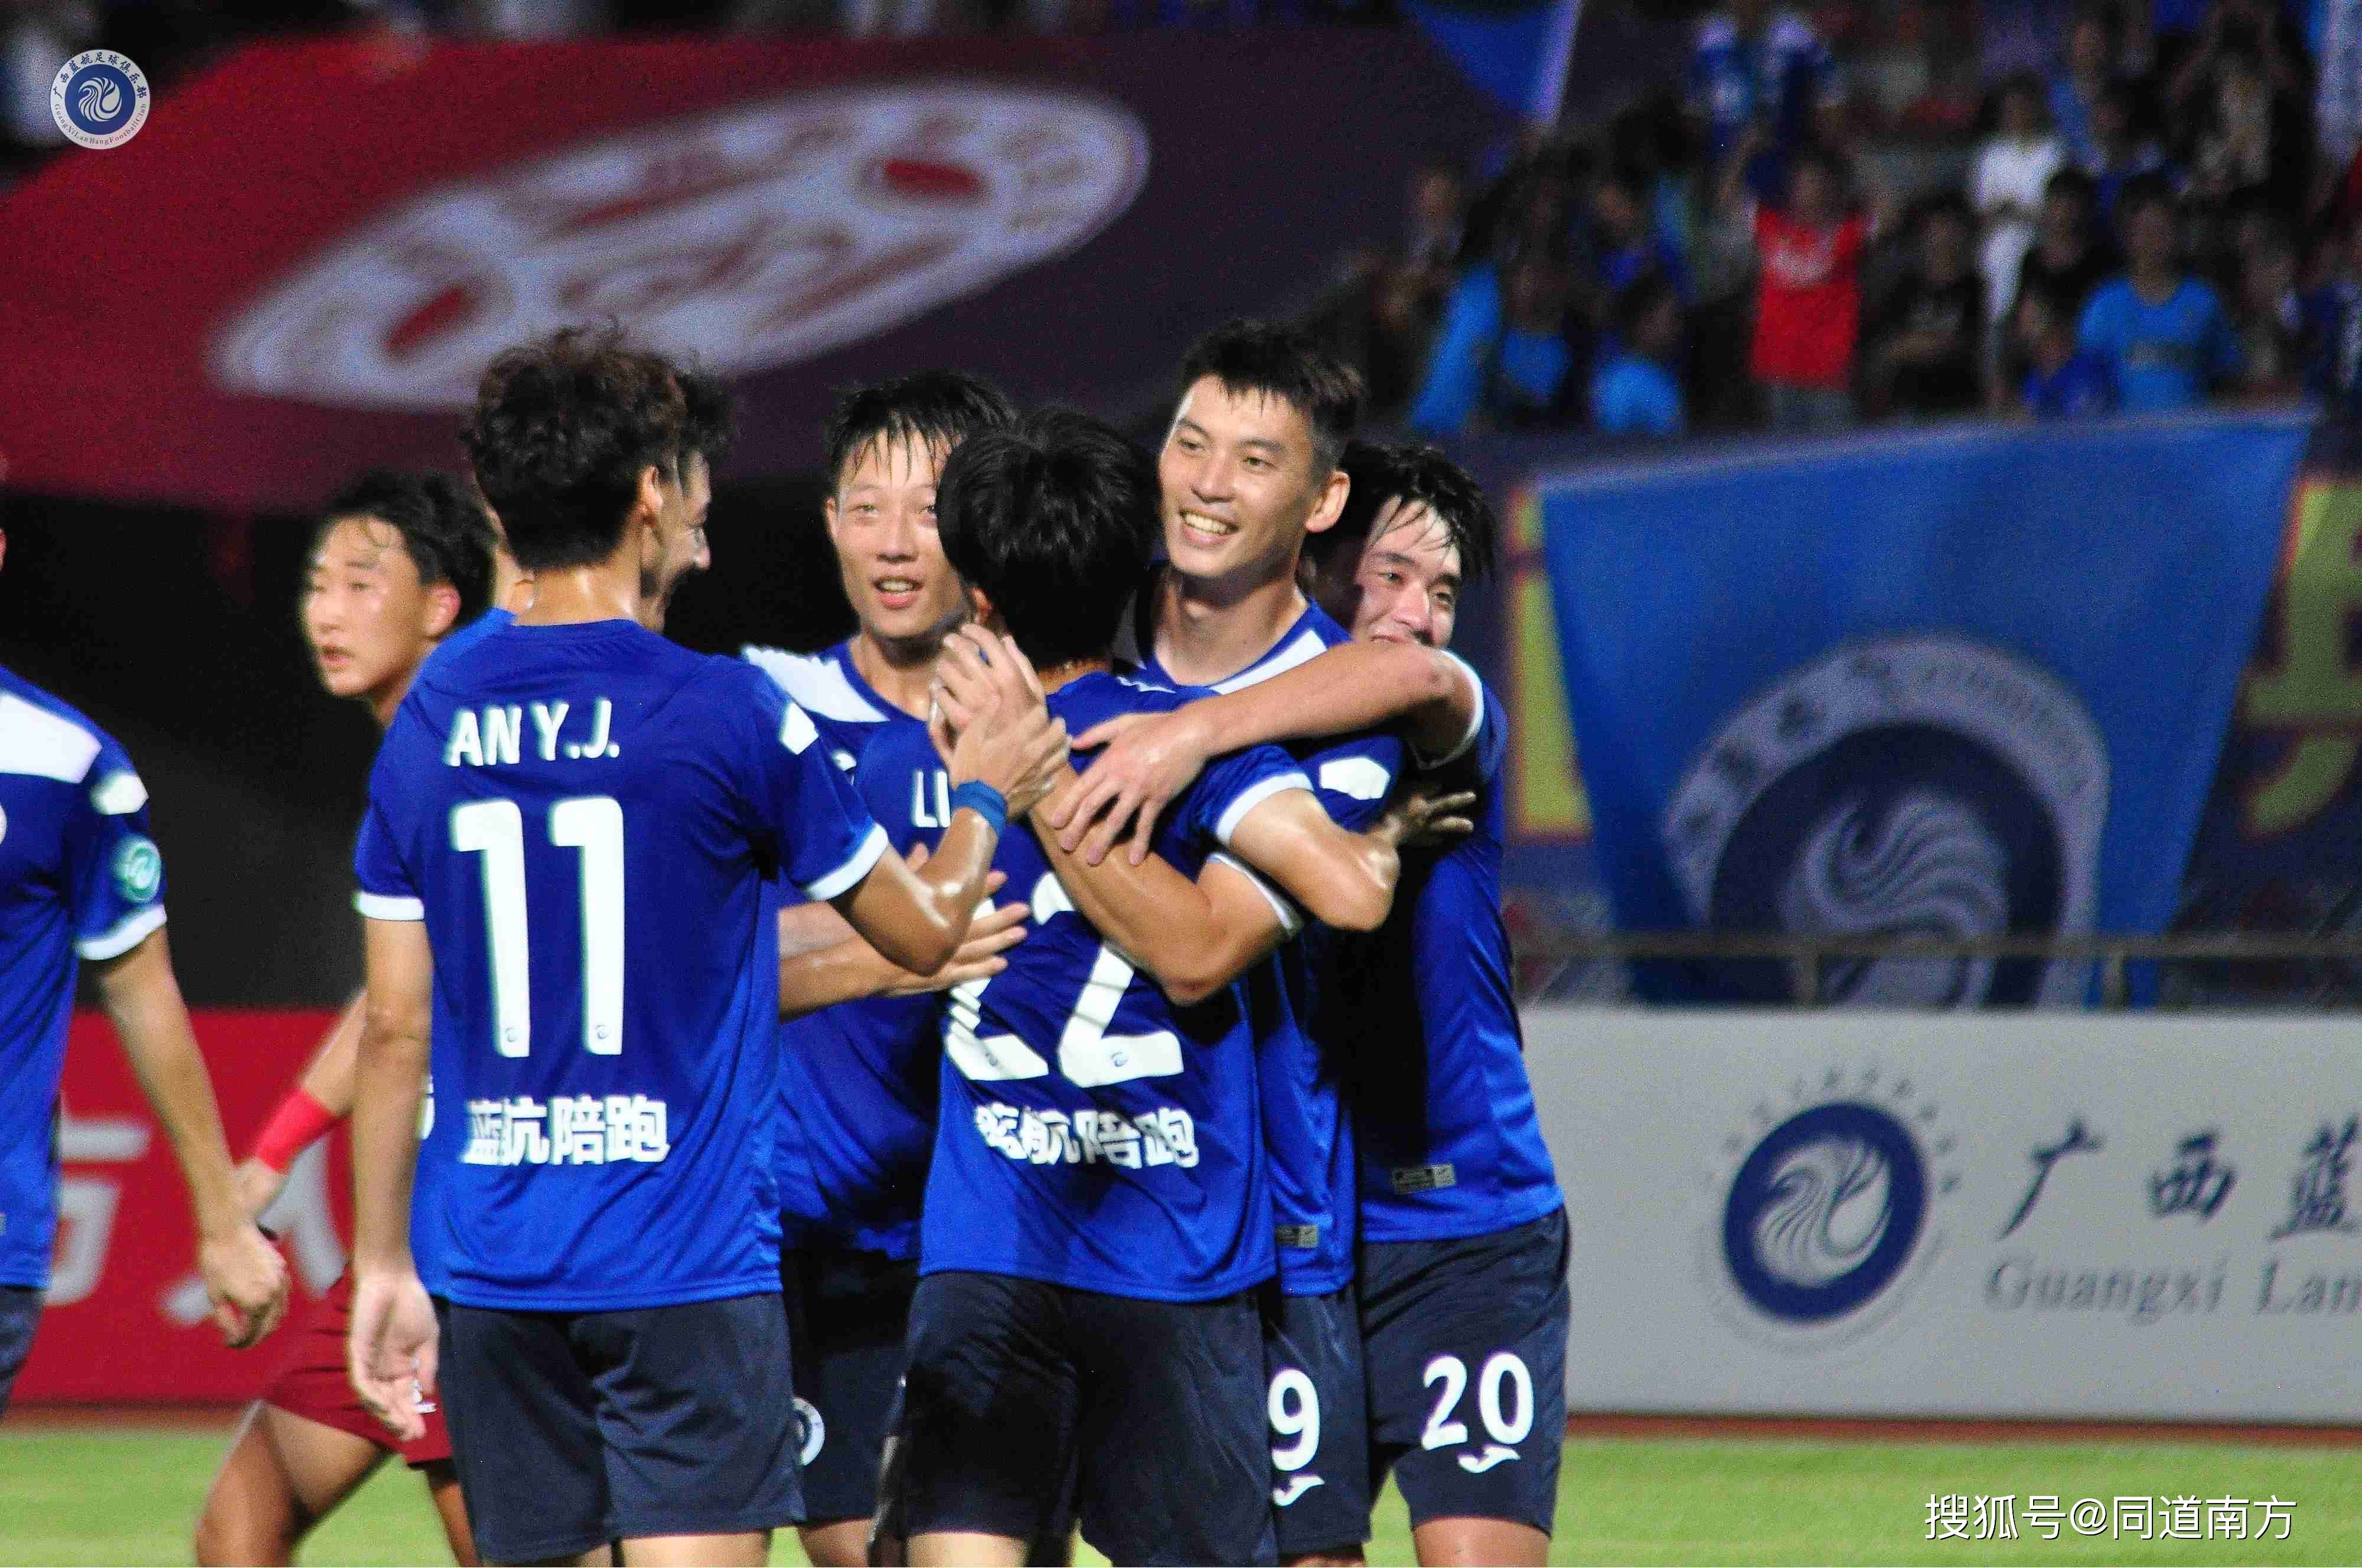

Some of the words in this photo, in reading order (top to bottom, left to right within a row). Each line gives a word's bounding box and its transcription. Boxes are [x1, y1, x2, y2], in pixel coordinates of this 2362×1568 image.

[444, 707, 522, 767] AN
[450, 796, 625, 1058] 11
[1267, 1368, 1322, 1471] 9
[1420, 1352, 1535, 1451] 20
